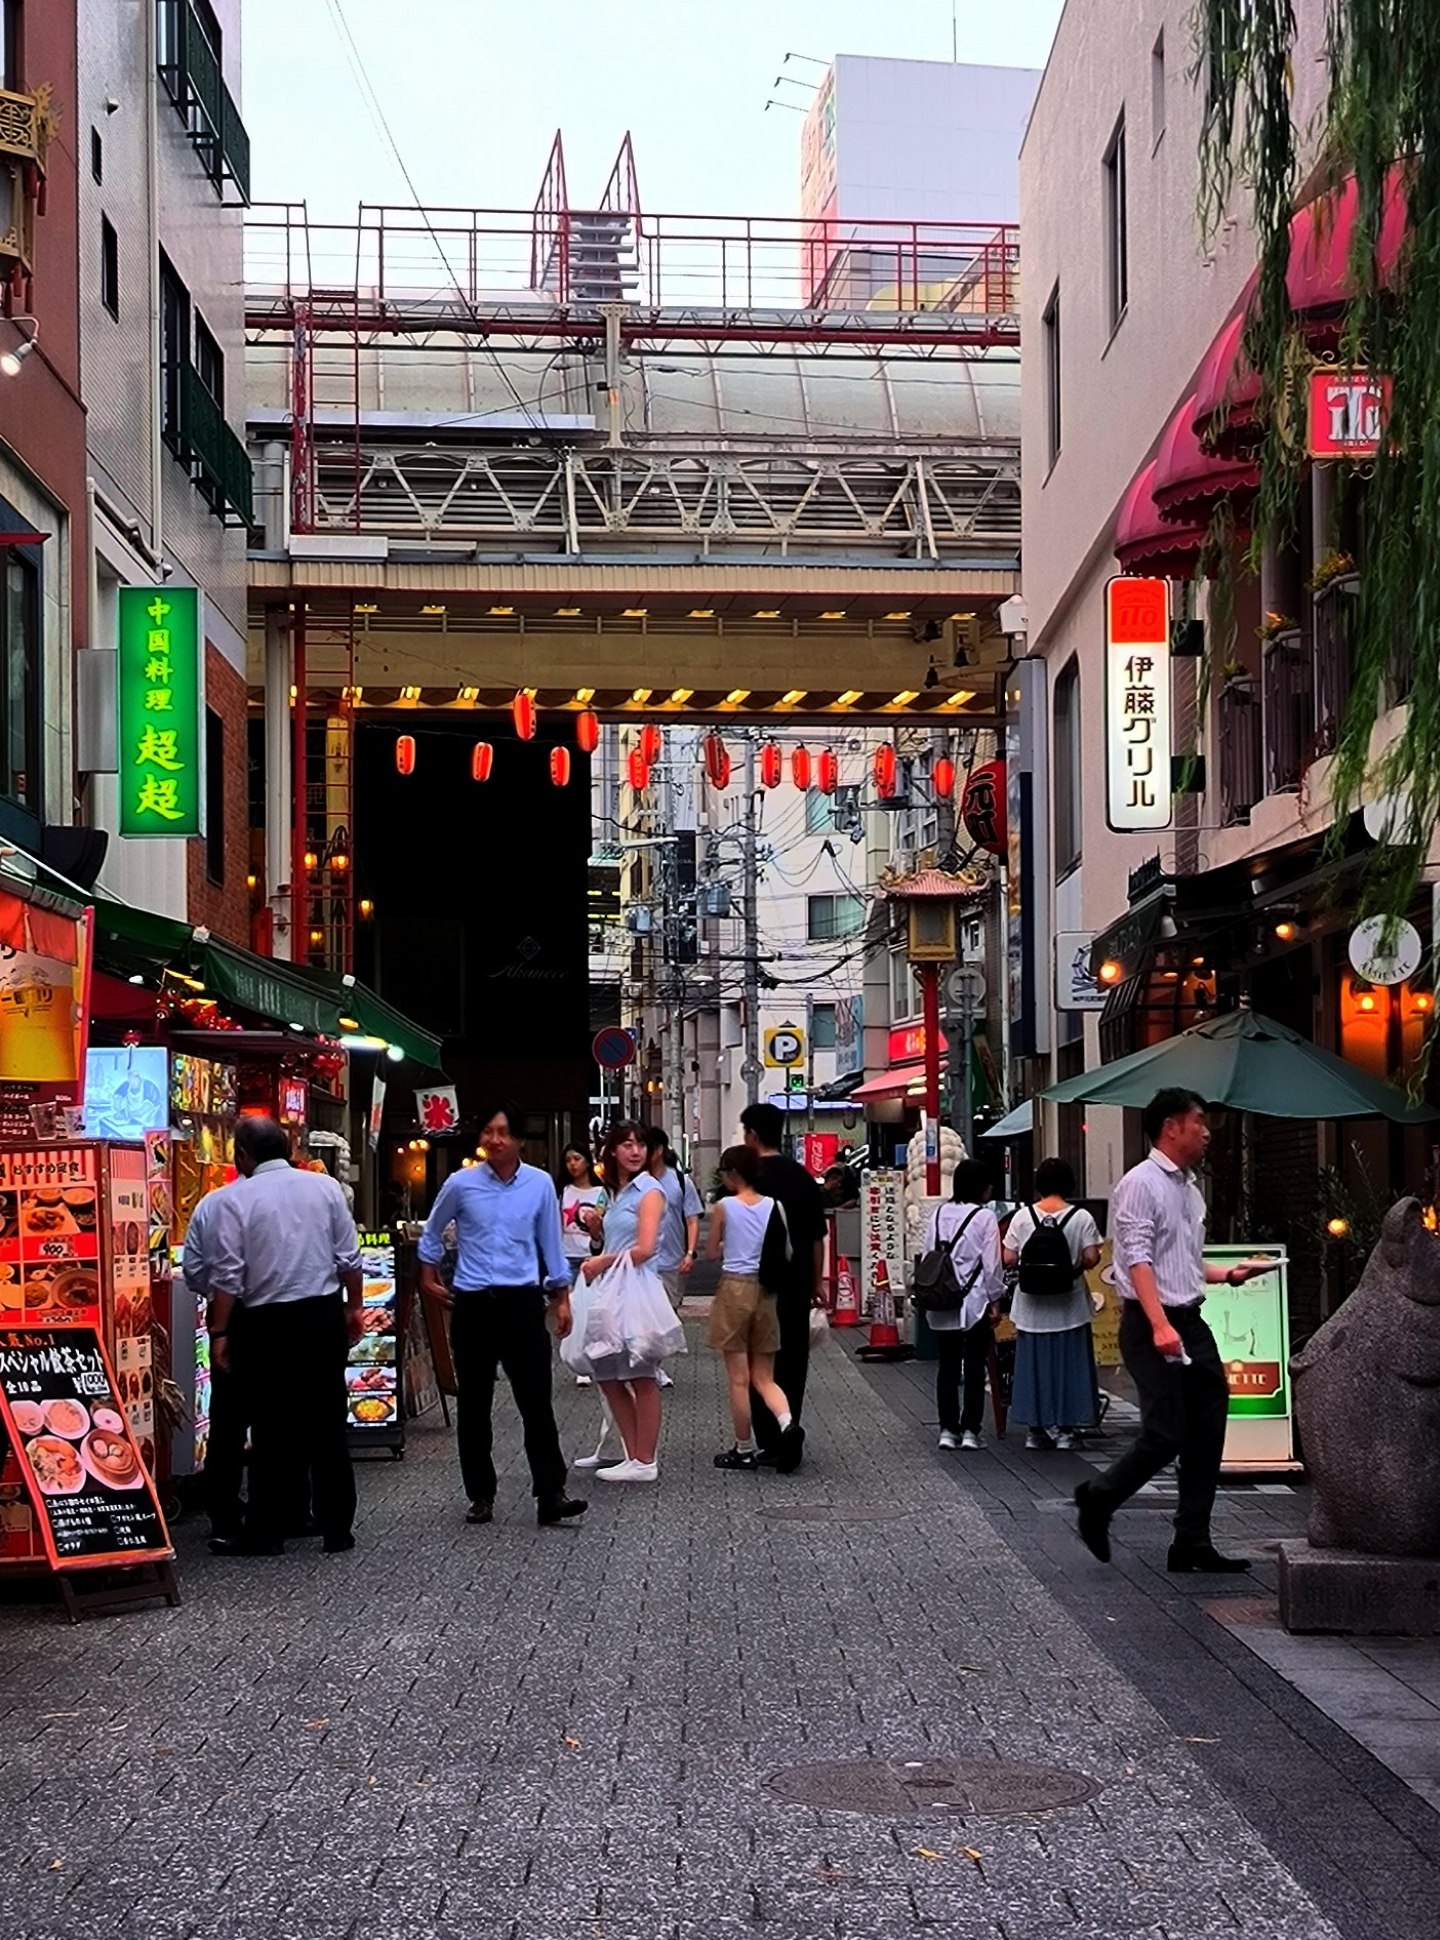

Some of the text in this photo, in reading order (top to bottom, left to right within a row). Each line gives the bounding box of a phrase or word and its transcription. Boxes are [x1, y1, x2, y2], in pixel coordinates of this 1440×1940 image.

[135, 596, 186, 820] 中国料理 超超
[1123, 655, 1156, 808] 伊藤グリル
[775, 1035, 798, 1060] P
